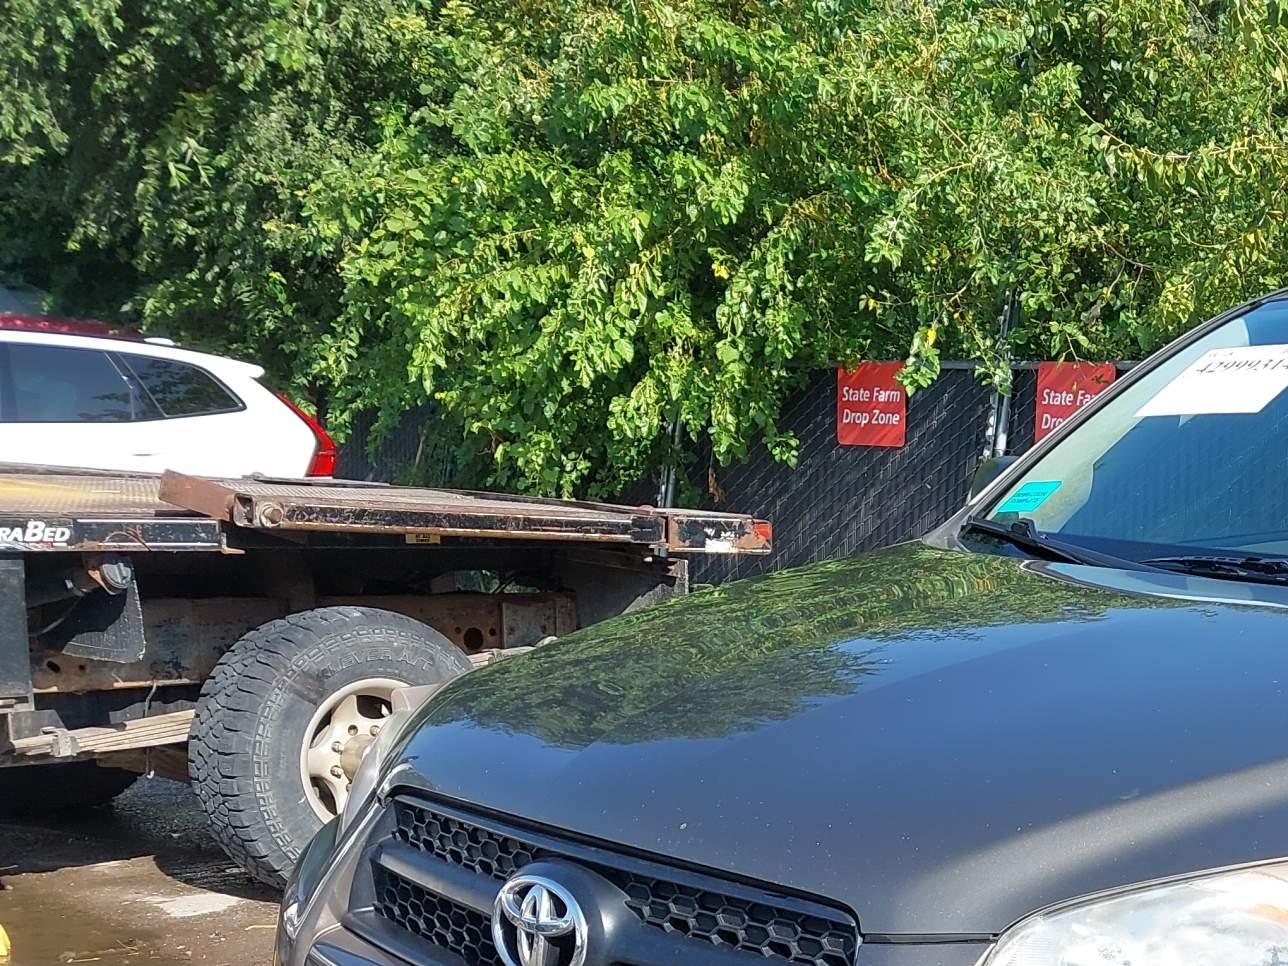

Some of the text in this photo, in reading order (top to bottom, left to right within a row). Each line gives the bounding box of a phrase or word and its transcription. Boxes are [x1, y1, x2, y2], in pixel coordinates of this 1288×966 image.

[842, 386, 901, 403] State Farm
[1041, 388, 1098, 406] State Fa
[842, 408, 900, 428] Drop Zone
[1041, 413, 1063, 430] Dro
